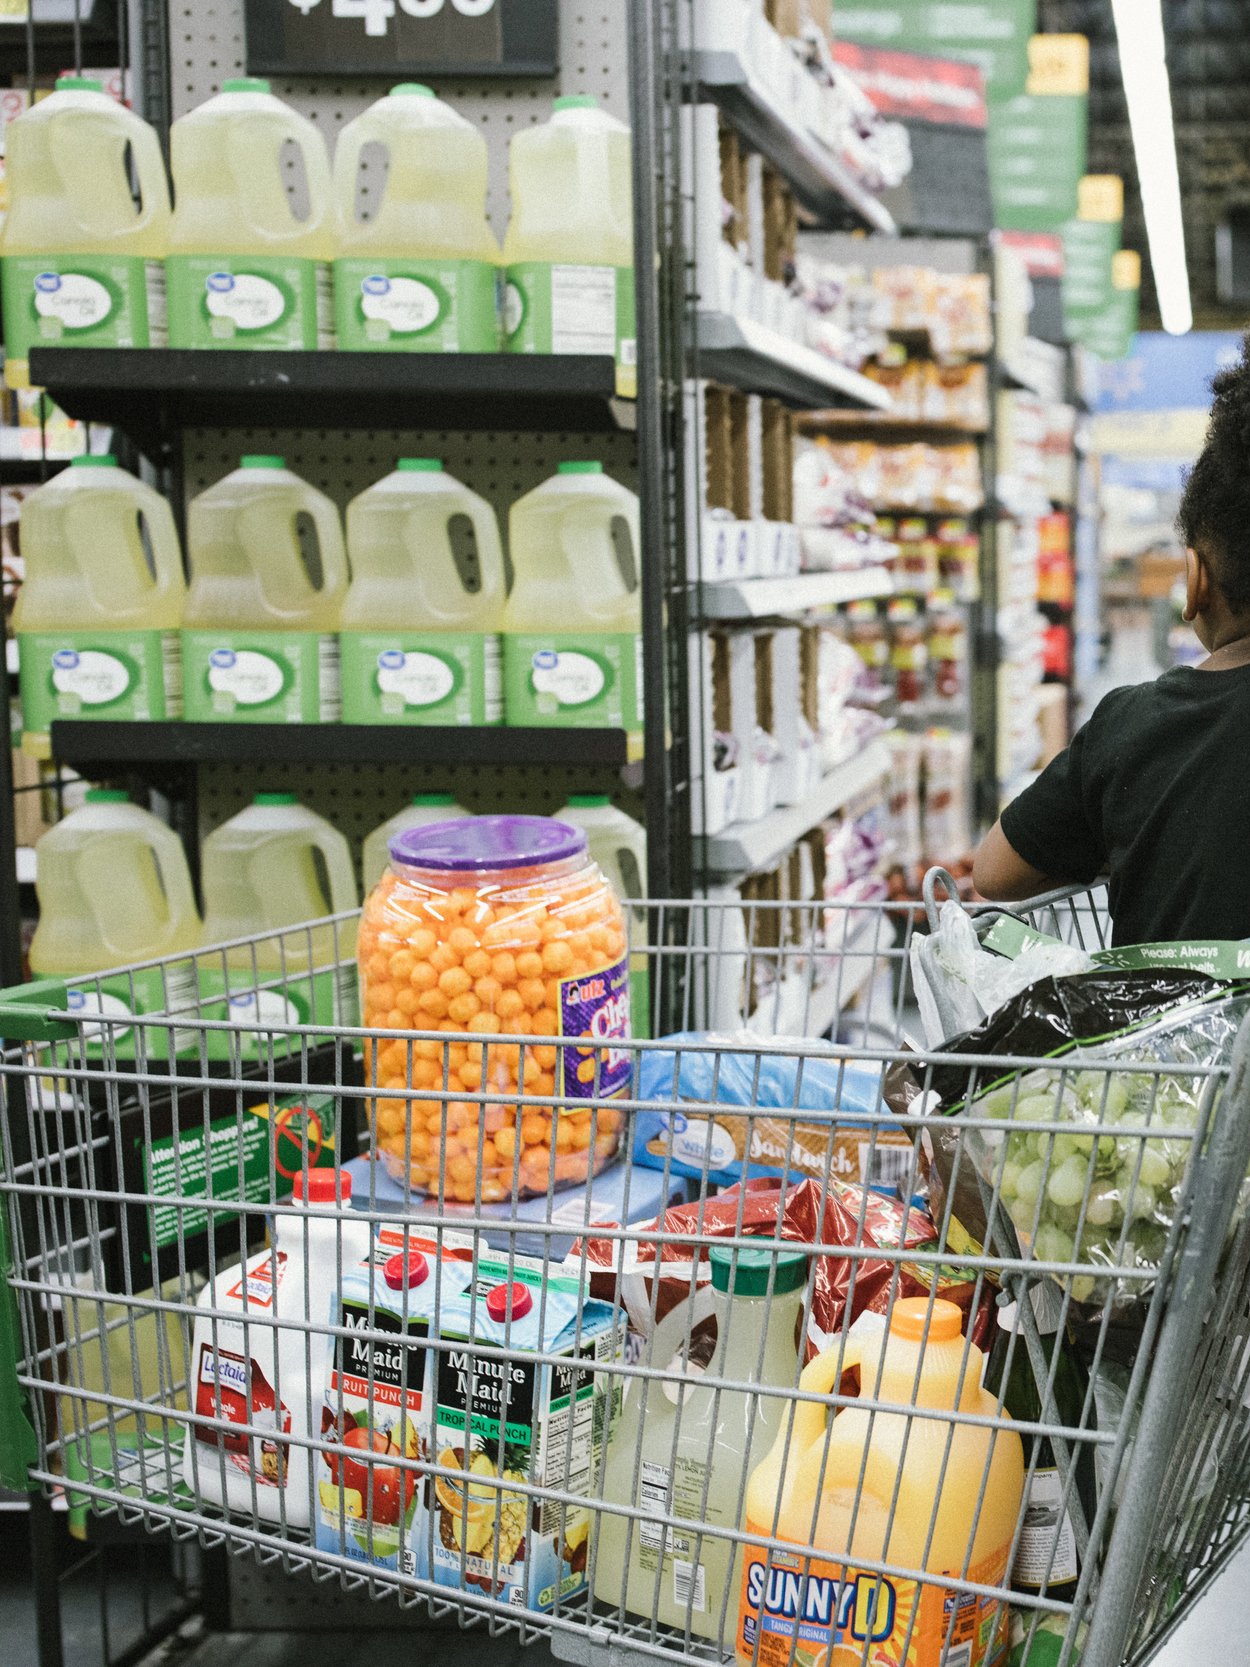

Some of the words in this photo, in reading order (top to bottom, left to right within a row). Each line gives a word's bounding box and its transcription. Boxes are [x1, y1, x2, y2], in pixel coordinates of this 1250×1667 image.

[1140, 948, 1178, 959] Please:
[1180, 945, 1218, 960] Always
[203, 1116, 258, 1146] hopprs!
[683, 1139, 725, 1158] Whte
[750, 1130, 856, 1173] Sandwich
[351, 1338, 404, 1371] Maid
[447, 1350, 526, 1384] Minute
[355, 1363, 399, 1381] PRMIUM
[560, 1369, 587, 1389] Mid
[341, 1378, 368, 1393] RUIT
[456, 1371, 513, 1405] Maid
[461, 1397, 504, 1414] PEMIU
[439, 1411, 488, 1433] TROPCAL
[490, 1423, 527, 1441] PUNCH
[435, 1547, 460, 1563] 100%
[465, 1556, 514, 1577] NATUAL
[771, 1619, 795, 1635] TANGY
[797, 1625, 828, 1642] RIGINAL
